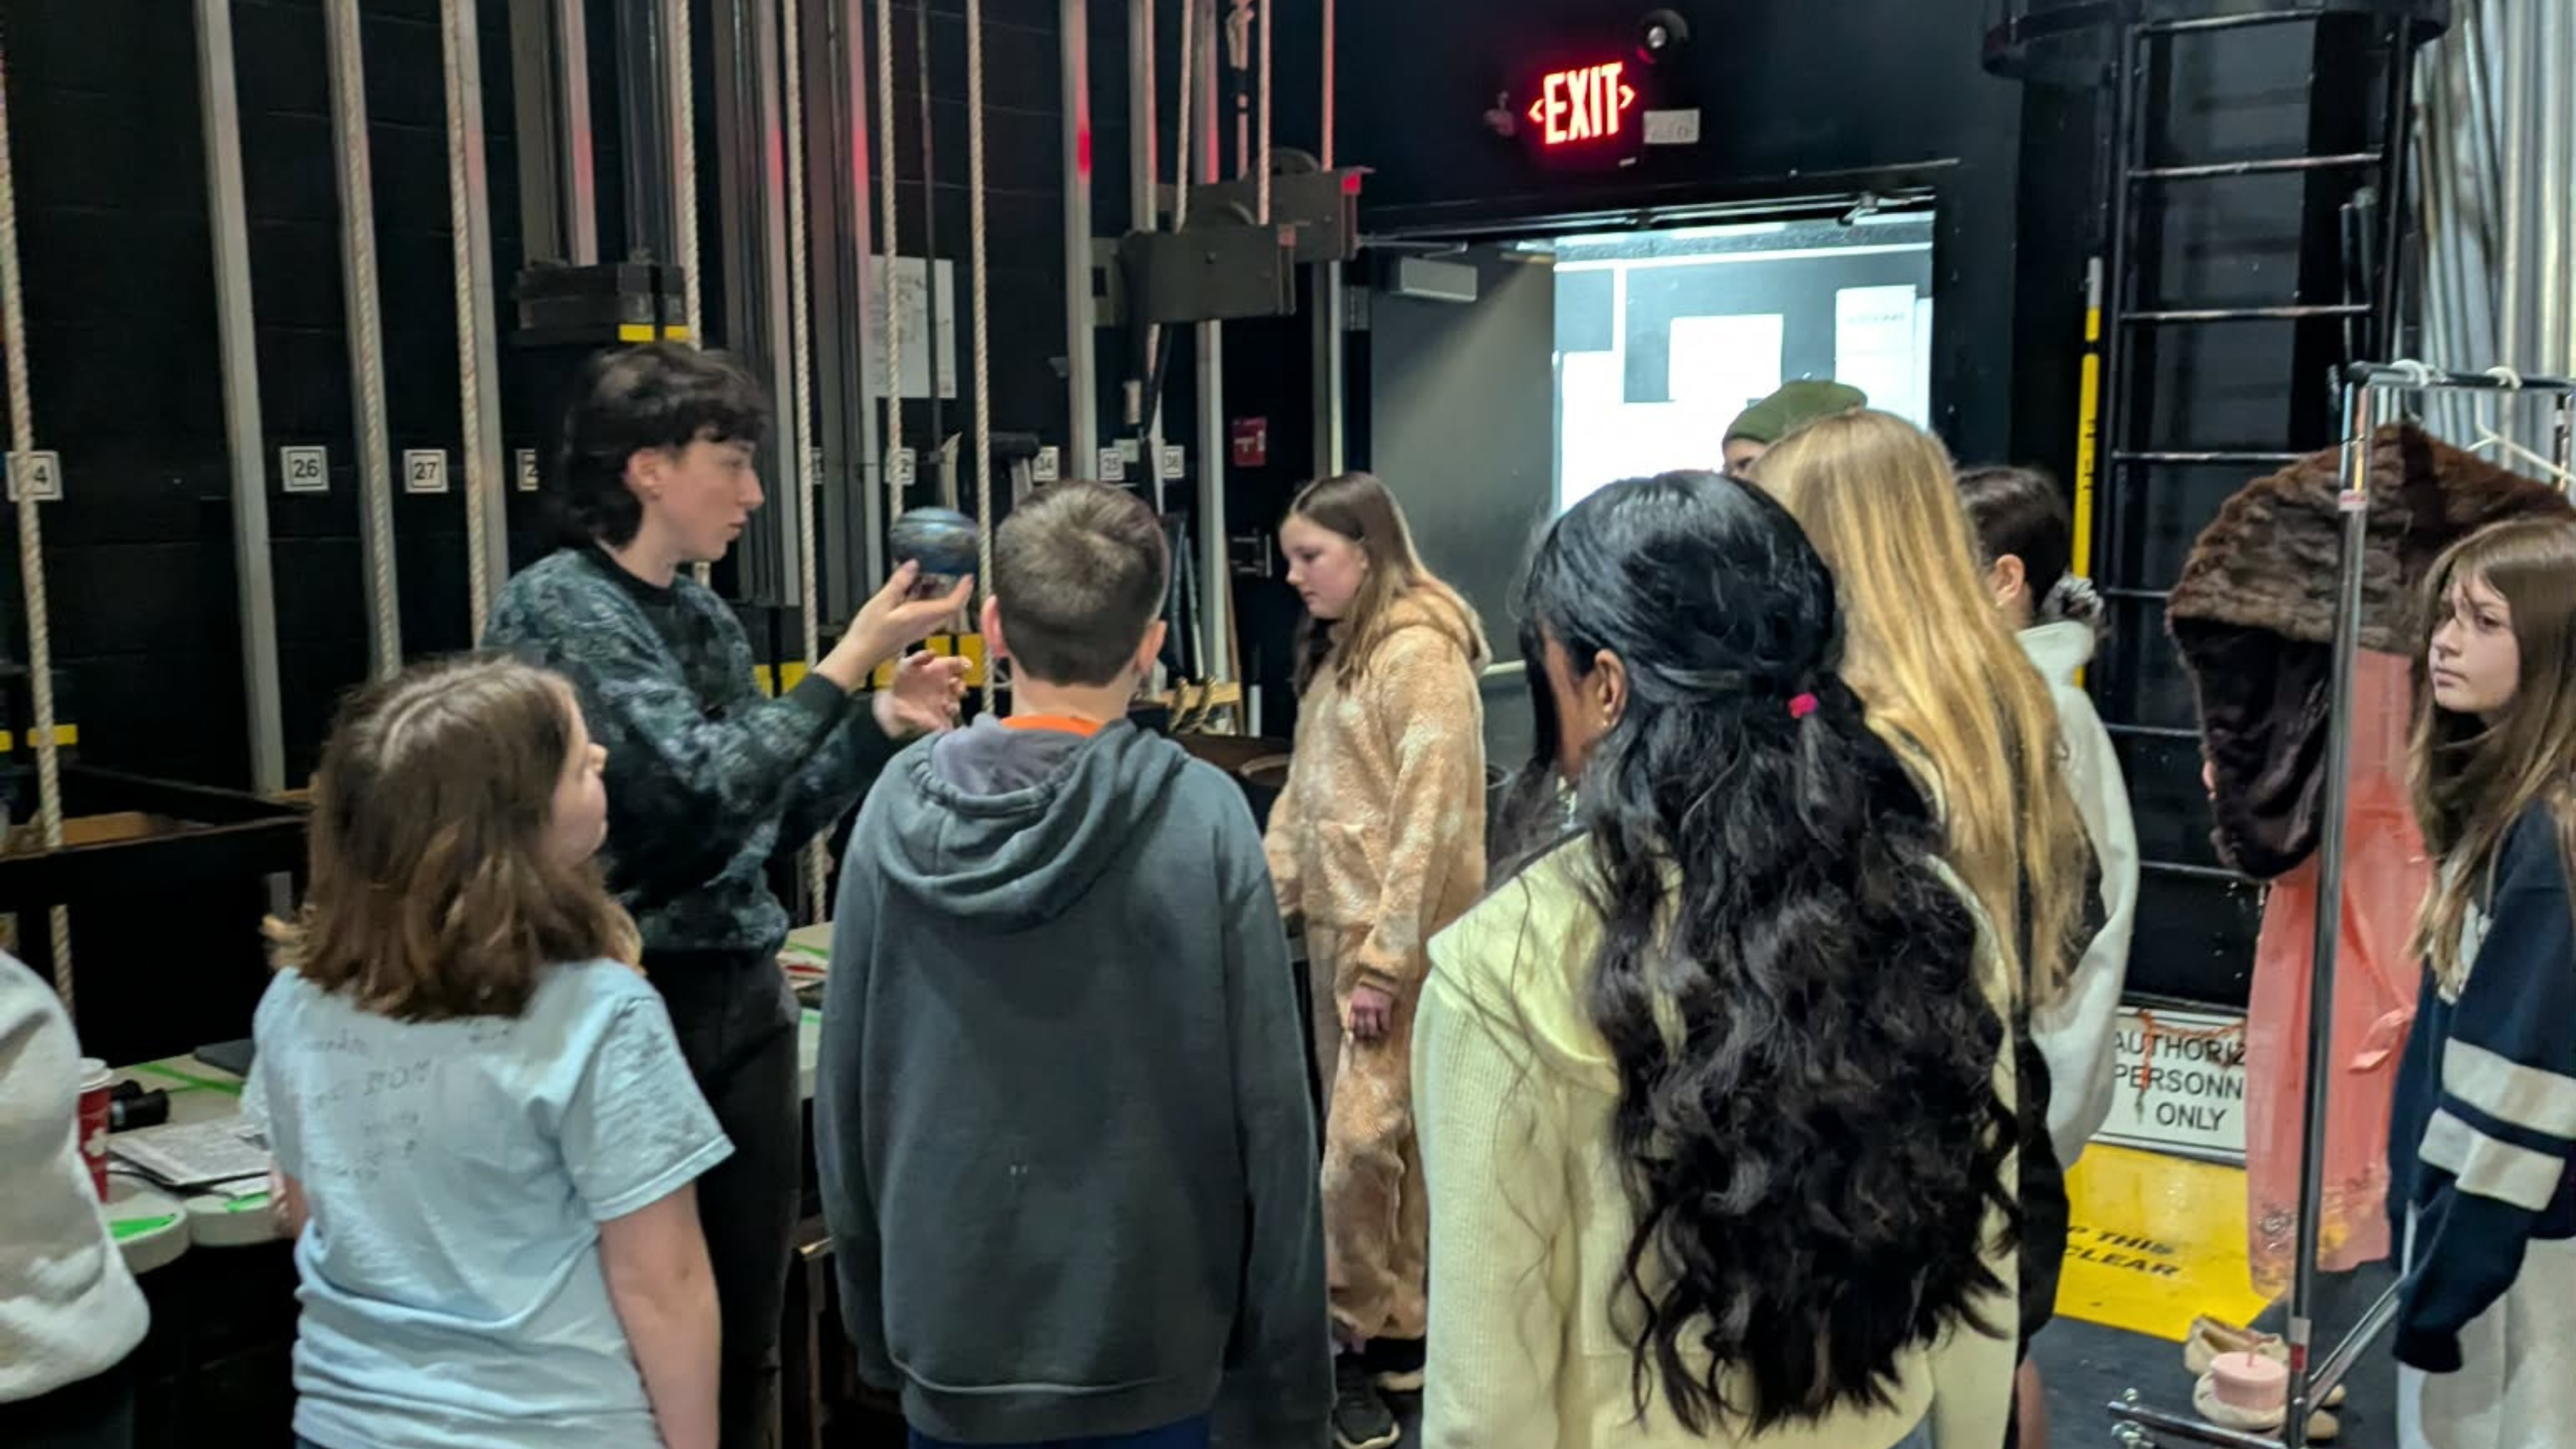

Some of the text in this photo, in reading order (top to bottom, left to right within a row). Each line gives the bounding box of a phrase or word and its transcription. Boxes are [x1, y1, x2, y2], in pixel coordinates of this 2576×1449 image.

[1544, 62, 1623, 144] EXIT
[293, 458, 320, 478] 26
[414, 462, 439, 480] 27
[2114, 1030, 2245, 1067] AUTHORIZ
[2114, 1063, 2244, 1099] PERSONN
[2156, 1102, 2227, 1131] ONLY
[2097, 1232, 2174, 1254] THIS
